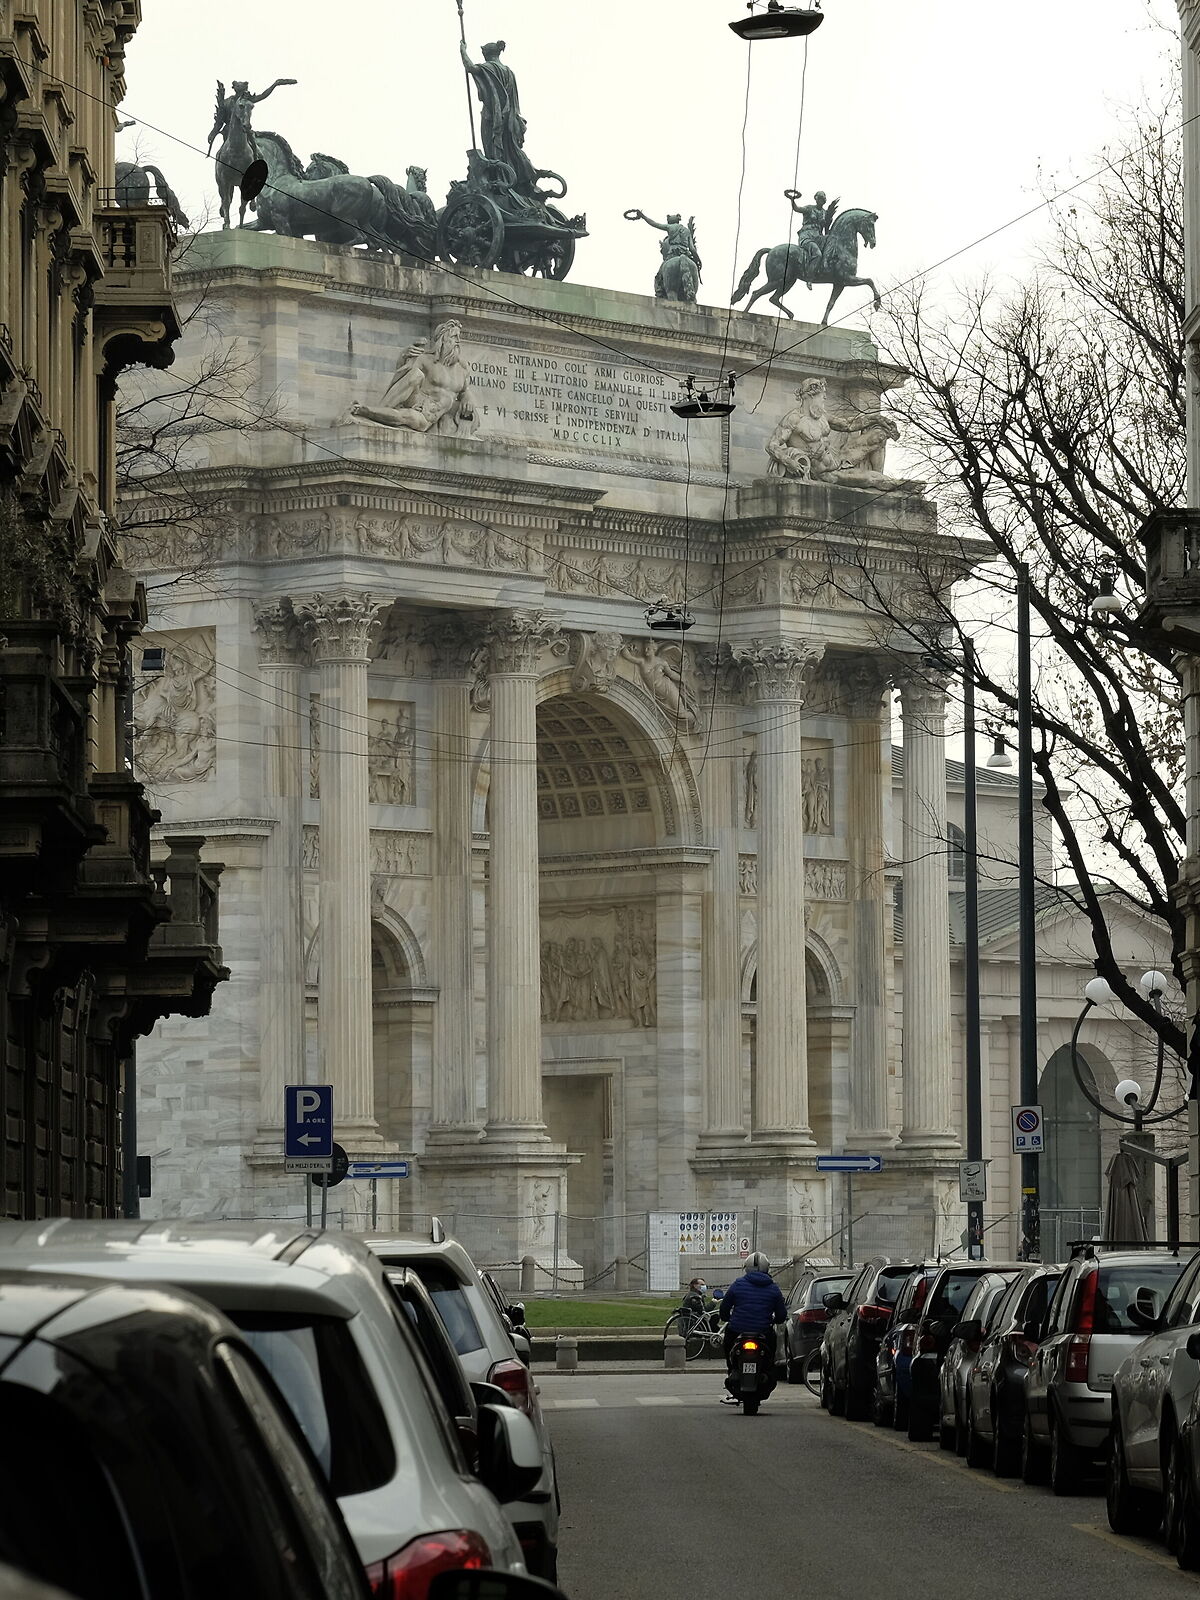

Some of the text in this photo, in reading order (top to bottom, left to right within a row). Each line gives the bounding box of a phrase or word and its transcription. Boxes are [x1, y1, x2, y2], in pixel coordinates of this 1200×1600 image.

[468, 361, 508, 377] OLEONE
[515, 368, 525, 379] III
[532, 371, 537, 381] E
[544, 372, 588, 388] VITTORIO
[594, 380, 643, 397] EMANUELE
[649, 388, 656, 398] II
[508, 353, 665, 386] ENTRANDO COLL' ARMI GLORIOSE
[469, 375, 506, 390] MILANO
[513, 382, 562, 398] ESULTANTE
[618, 397, 630, 408] DA
[635, 400, 667, 413] QUESTI
[534, 399, 639, 423] LE IMPRONTE SERVILI
[483, 405, 489, 416] E
[496, 406, 506, 418] VI
[513, 409, 549, 424] SCRISSE
[567, 417, 637, 436] INDIPENDENZA
[656, 429, 687, 442] ITALIA
[296, 1090, 321, 1124] P
